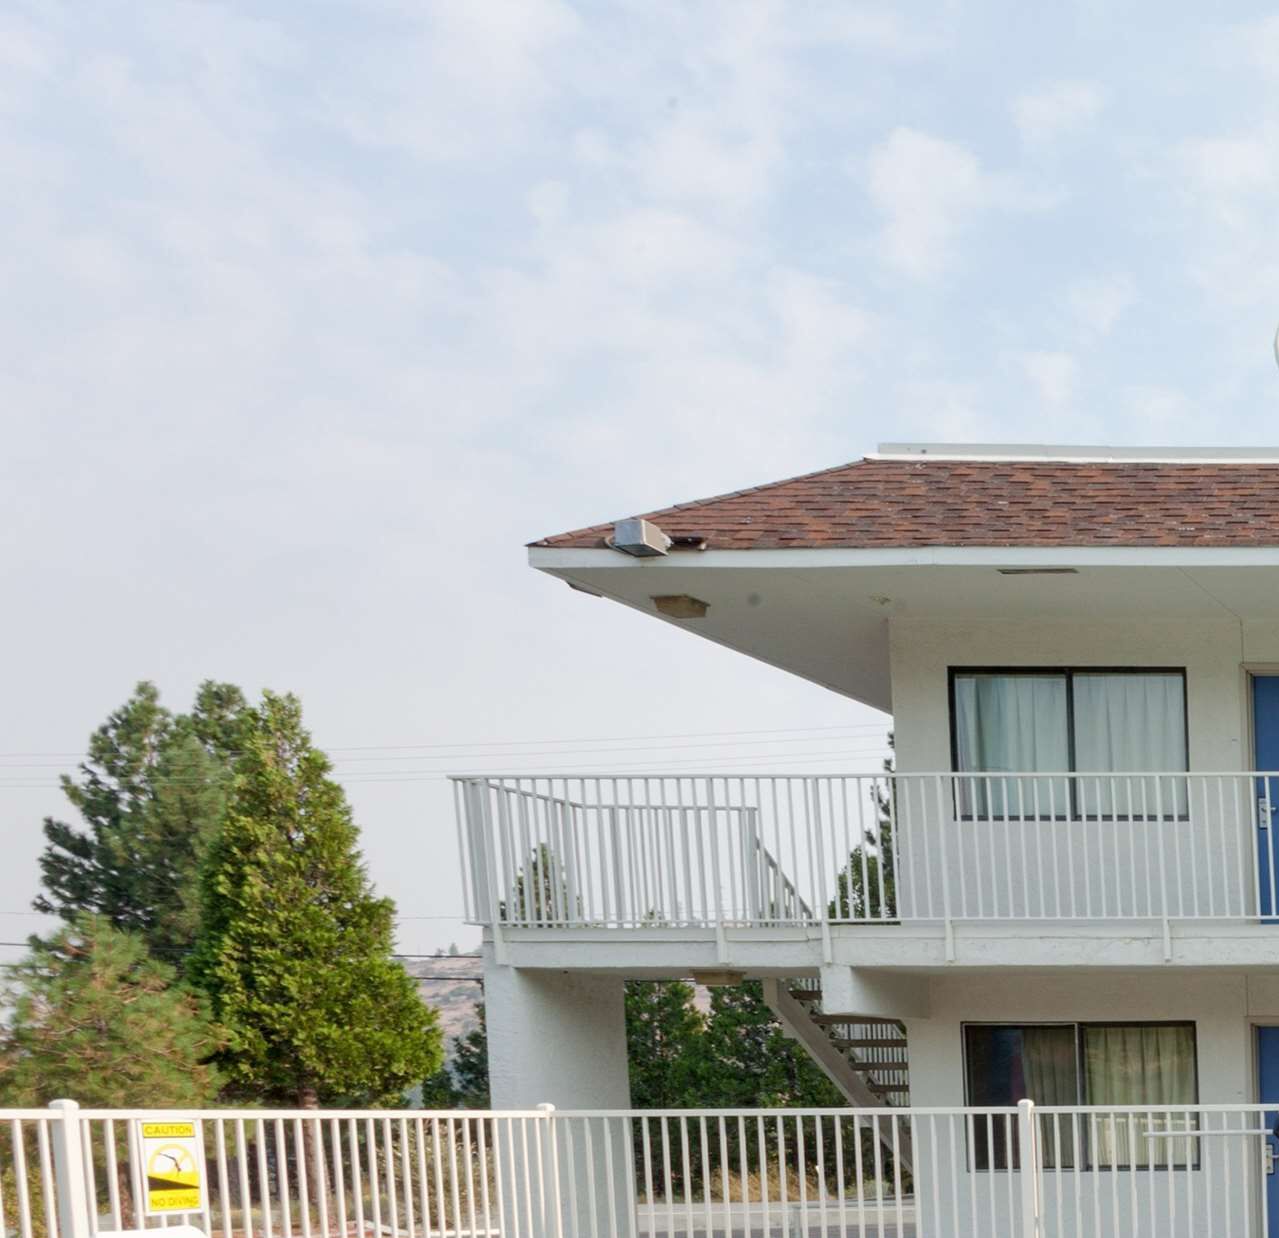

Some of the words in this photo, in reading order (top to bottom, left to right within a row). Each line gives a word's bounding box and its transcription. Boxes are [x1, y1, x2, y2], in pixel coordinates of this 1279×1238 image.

[144, 1126, 192, 1135] CAUTION
[151, 1198, 166, 1207] NO
[168, 1196, 199, 1207] DIVING
